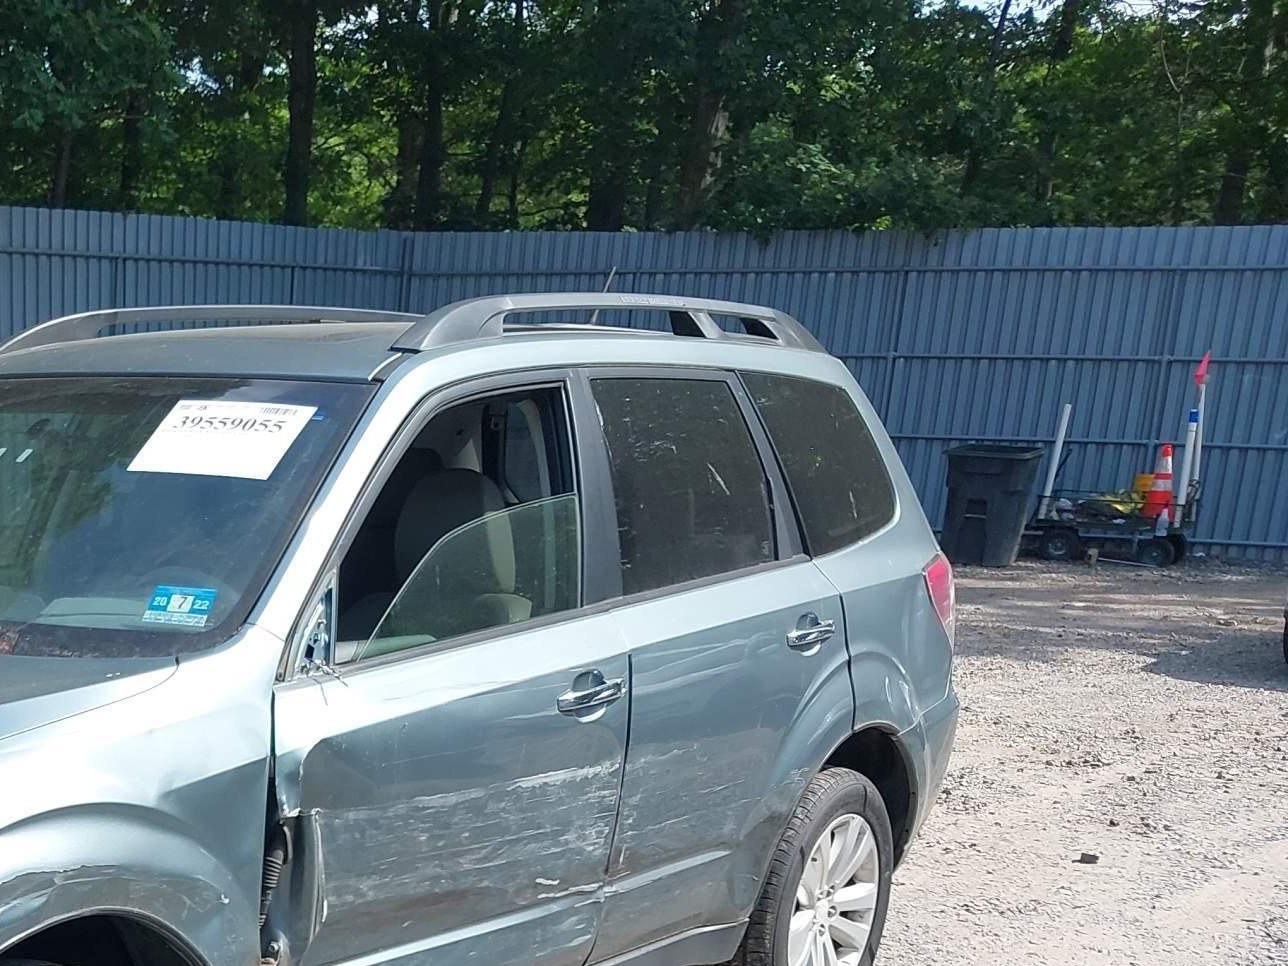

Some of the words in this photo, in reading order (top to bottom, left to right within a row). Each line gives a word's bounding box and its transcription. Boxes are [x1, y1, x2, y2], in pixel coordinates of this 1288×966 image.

[173, 415, 289, 434] 39559055
[152, 596, 168, 607] 20
[177, 596, 188, 609] 7
[193, 599, 210, 610] 22
